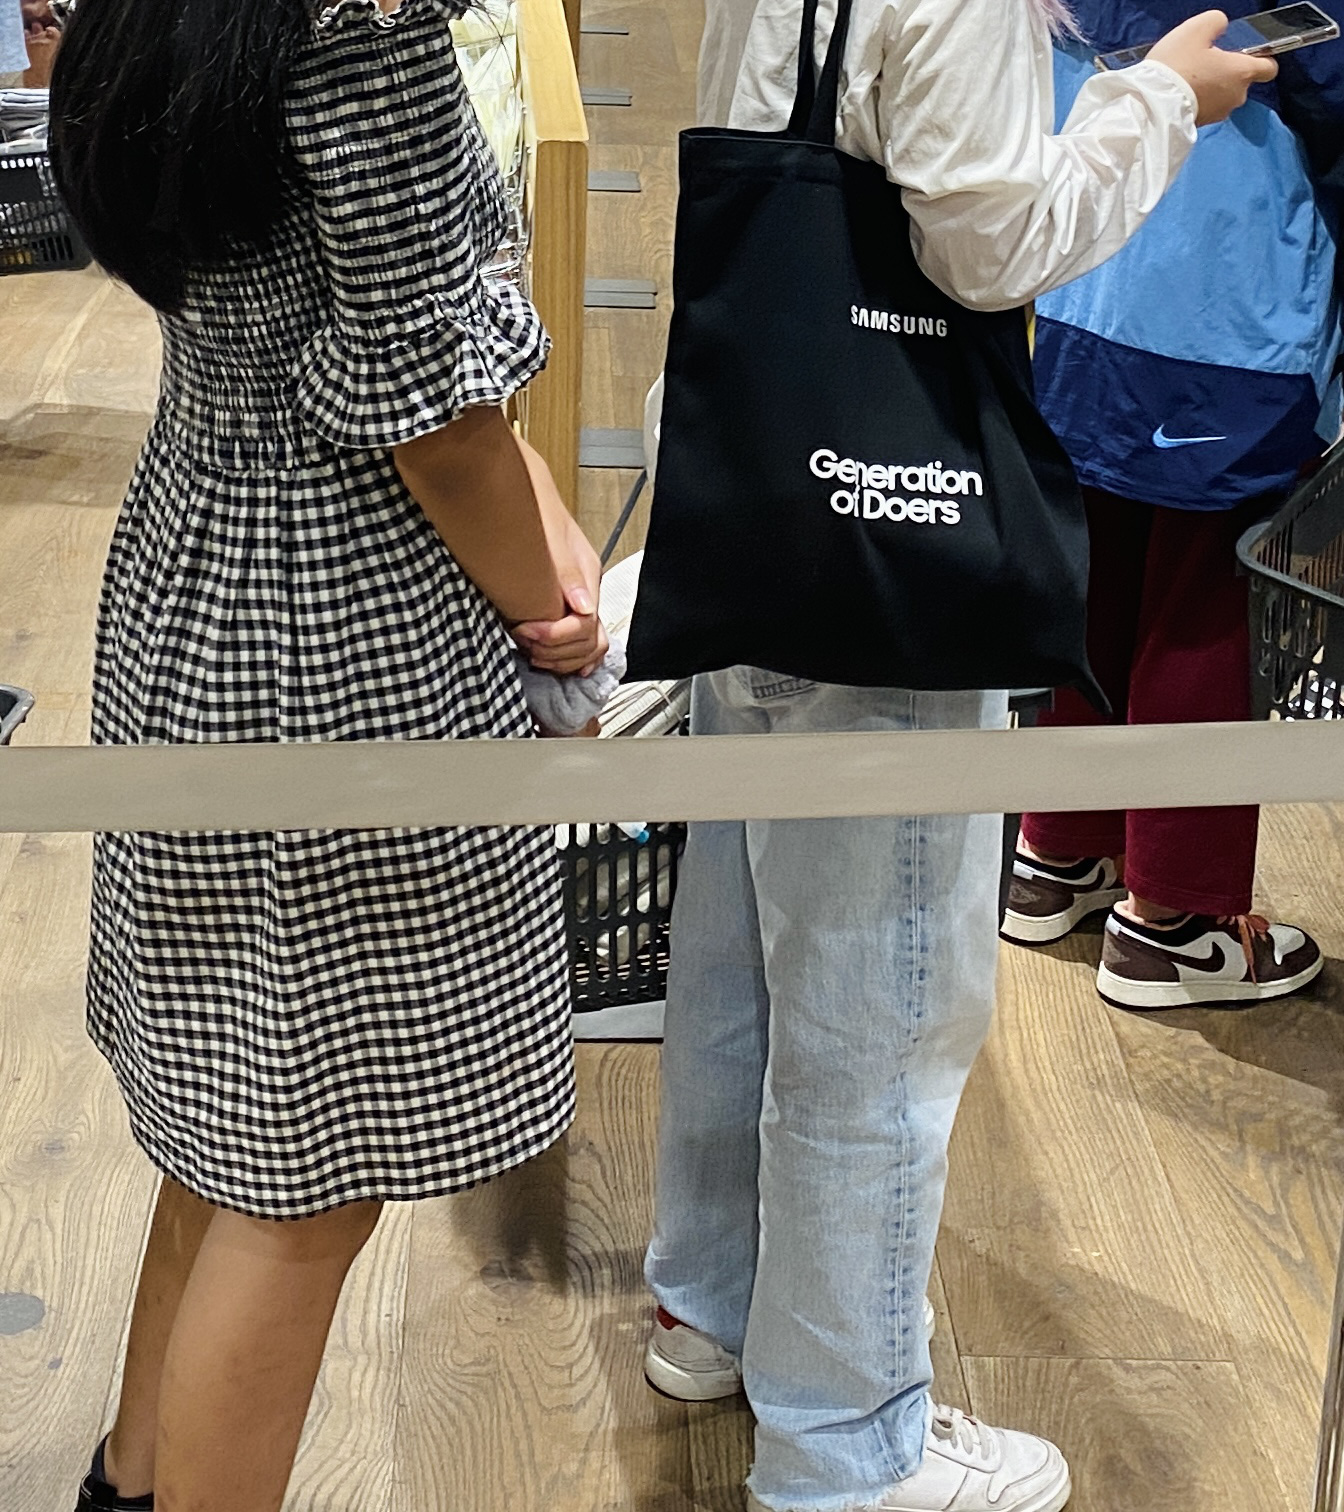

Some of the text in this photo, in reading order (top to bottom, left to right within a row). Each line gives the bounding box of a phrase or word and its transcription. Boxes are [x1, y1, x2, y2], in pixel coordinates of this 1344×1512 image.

[850, 304, 948, 337] SAMSUNG
[809, 448, 983, 497] Generation
[862, 488, 961, 525] Doers
